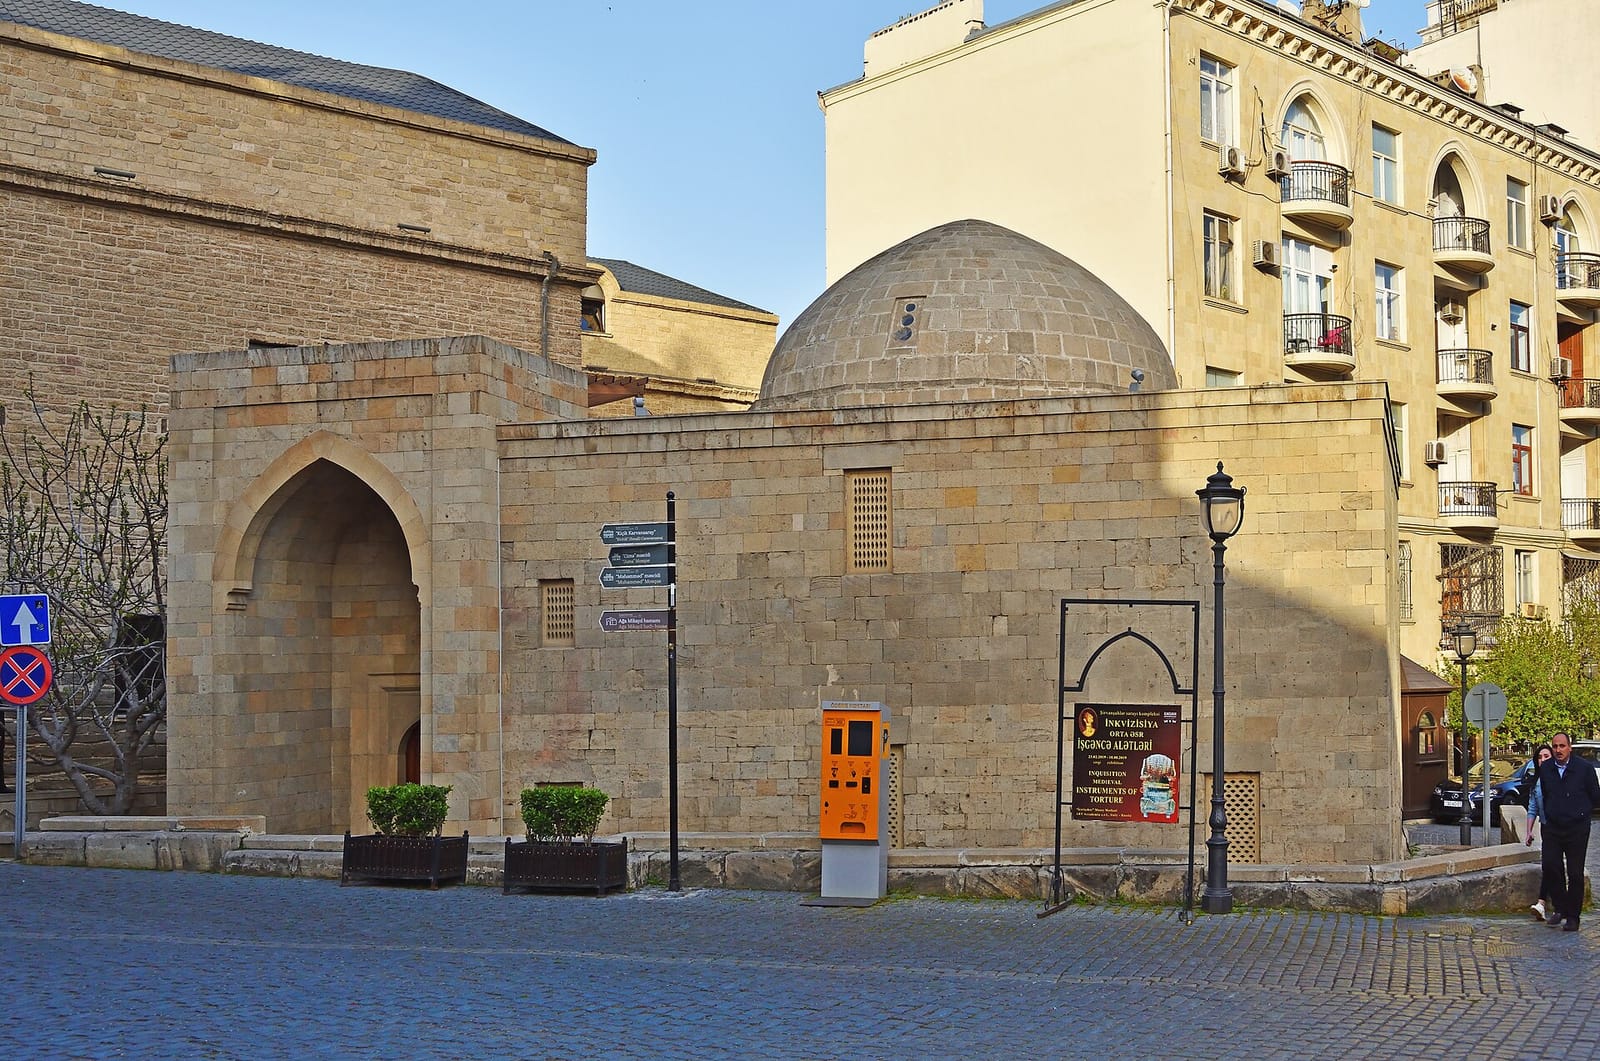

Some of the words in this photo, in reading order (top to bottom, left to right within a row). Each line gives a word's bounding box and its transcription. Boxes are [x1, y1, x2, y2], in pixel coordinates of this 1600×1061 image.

[1105, 718, 1158, 728] İNKVİZİSİYA
[1077, 738, 1112, 751] İŞGƏNCƏ
[1113, 739, 1152, 750] ALƏTLƏRİ
[1076, 786, 1126, 794] INSTRUMENTS
[1090, 796, 1124, 804] TORTURE
